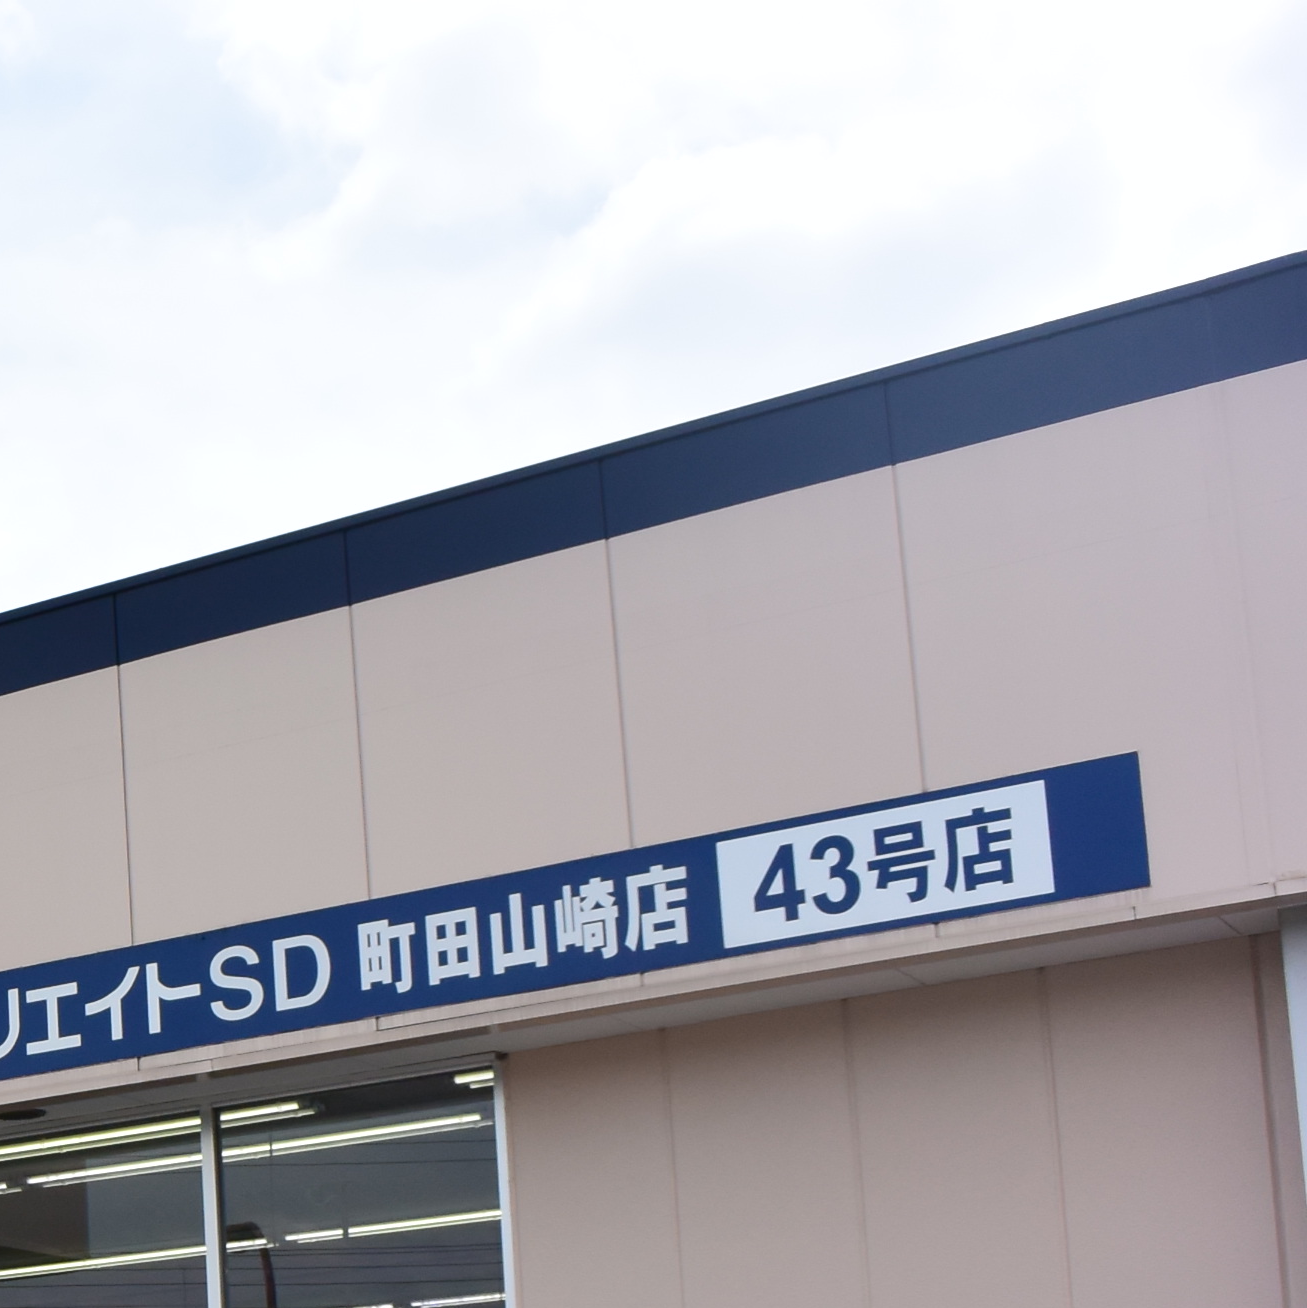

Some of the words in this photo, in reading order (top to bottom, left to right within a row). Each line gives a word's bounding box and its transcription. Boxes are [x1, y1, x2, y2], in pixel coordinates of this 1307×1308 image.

[752, 806, 1014, 923] 43号店
[356, 864, 690, 995] 町田山崎店
